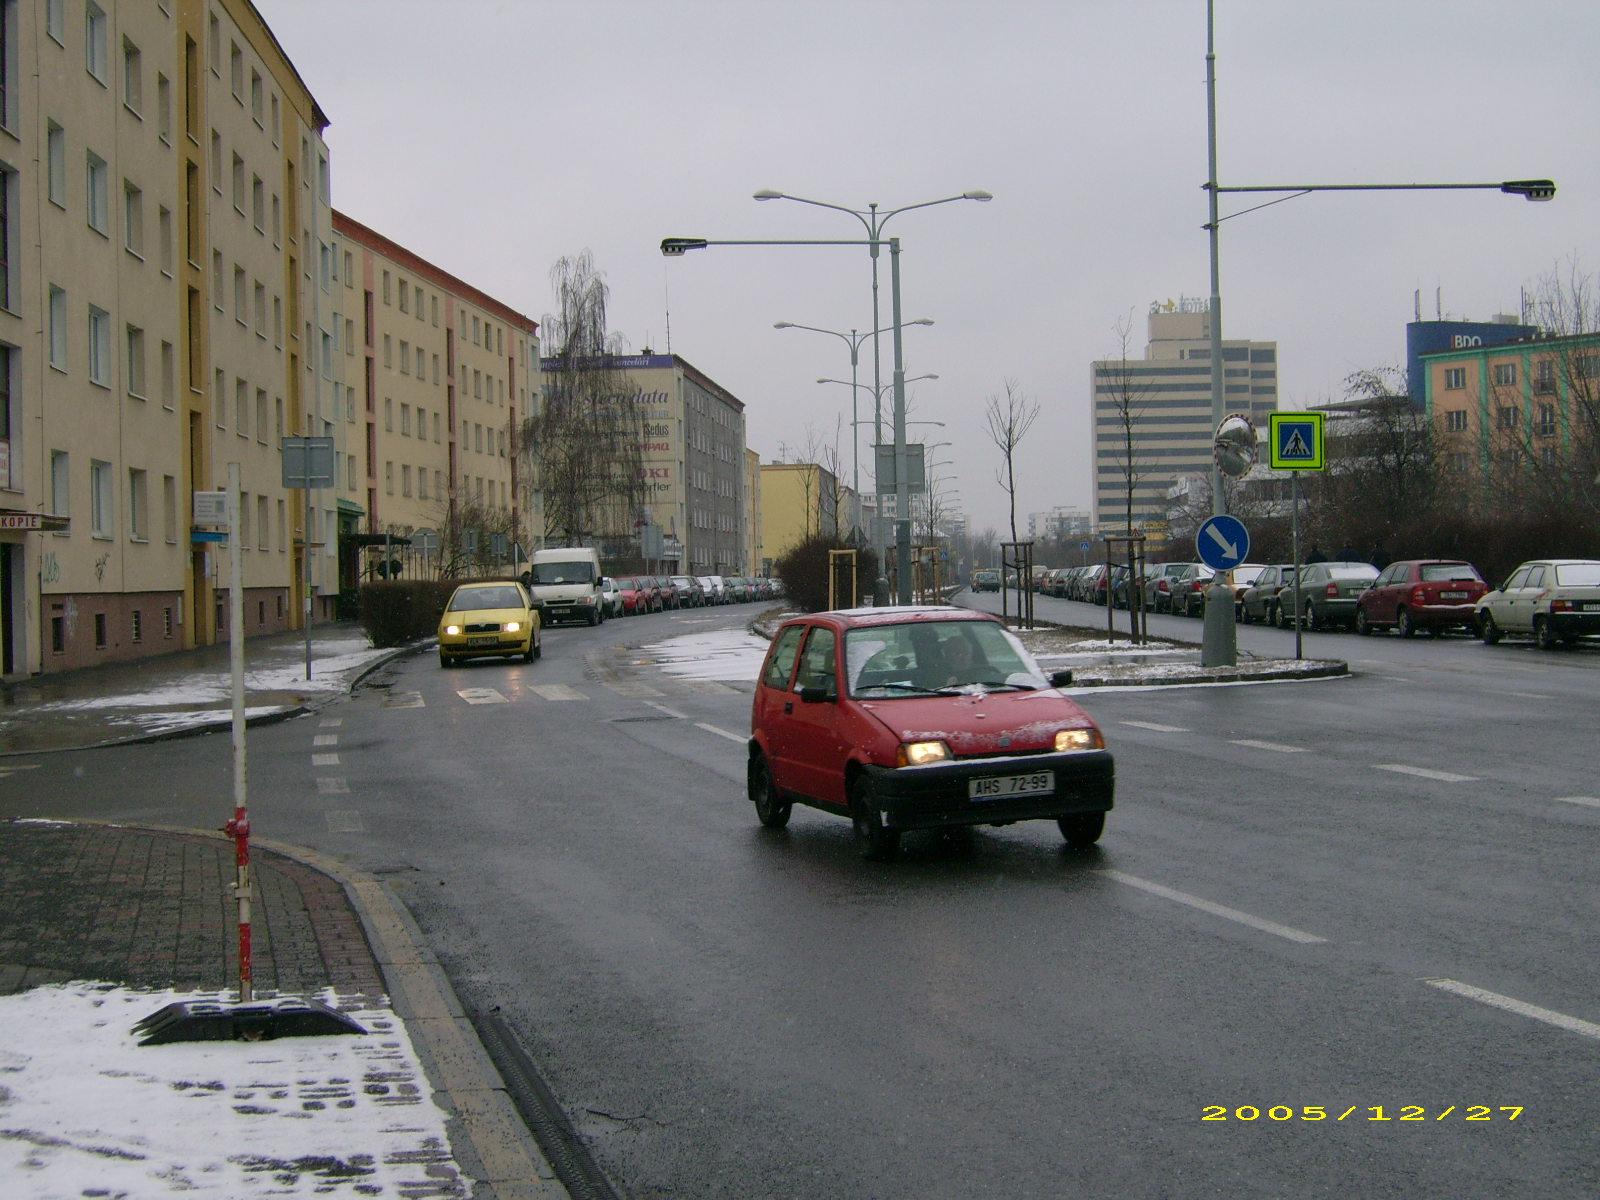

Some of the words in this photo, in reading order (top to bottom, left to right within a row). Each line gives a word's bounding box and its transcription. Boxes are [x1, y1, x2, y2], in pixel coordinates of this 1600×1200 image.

[645, 422, 669, 436] Sedus
[636, 467, 670, 480] OKI
[1, 517, 38, 528] KOPIE
[975, 780, 1000, 795] AHS
[1009, 775, 1048, 792] 72-99
